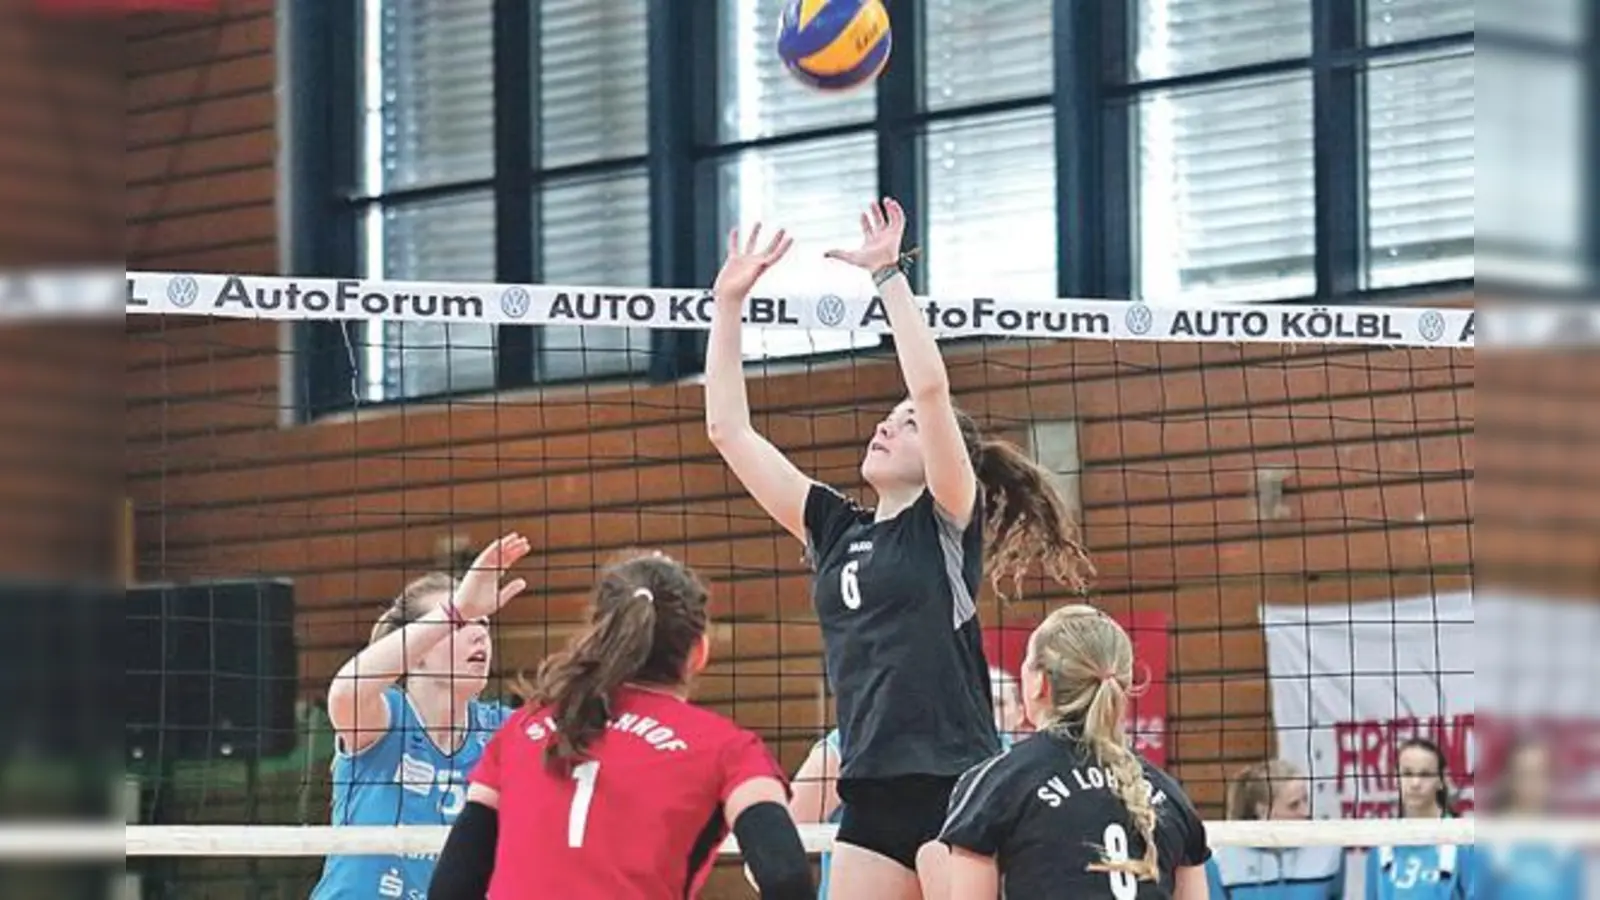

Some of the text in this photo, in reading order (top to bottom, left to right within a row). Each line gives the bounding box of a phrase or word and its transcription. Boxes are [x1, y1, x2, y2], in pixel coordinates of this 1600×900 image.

[214, 276, 483, 318] AutoForum
[549, 293, 655, 322] AUTO
[669, 291, 798, 325] KÖBL
[860, 296, 1110, 333] AtoForum
[1169, 311, 1268, 337] AUTO
[1281, 308, 1402, 340] KÖLBL
[841, 560, 861, 609] 6
[568, 760, 600, 848] 1
[1037, 766, 1167, 808] SV LOHF
